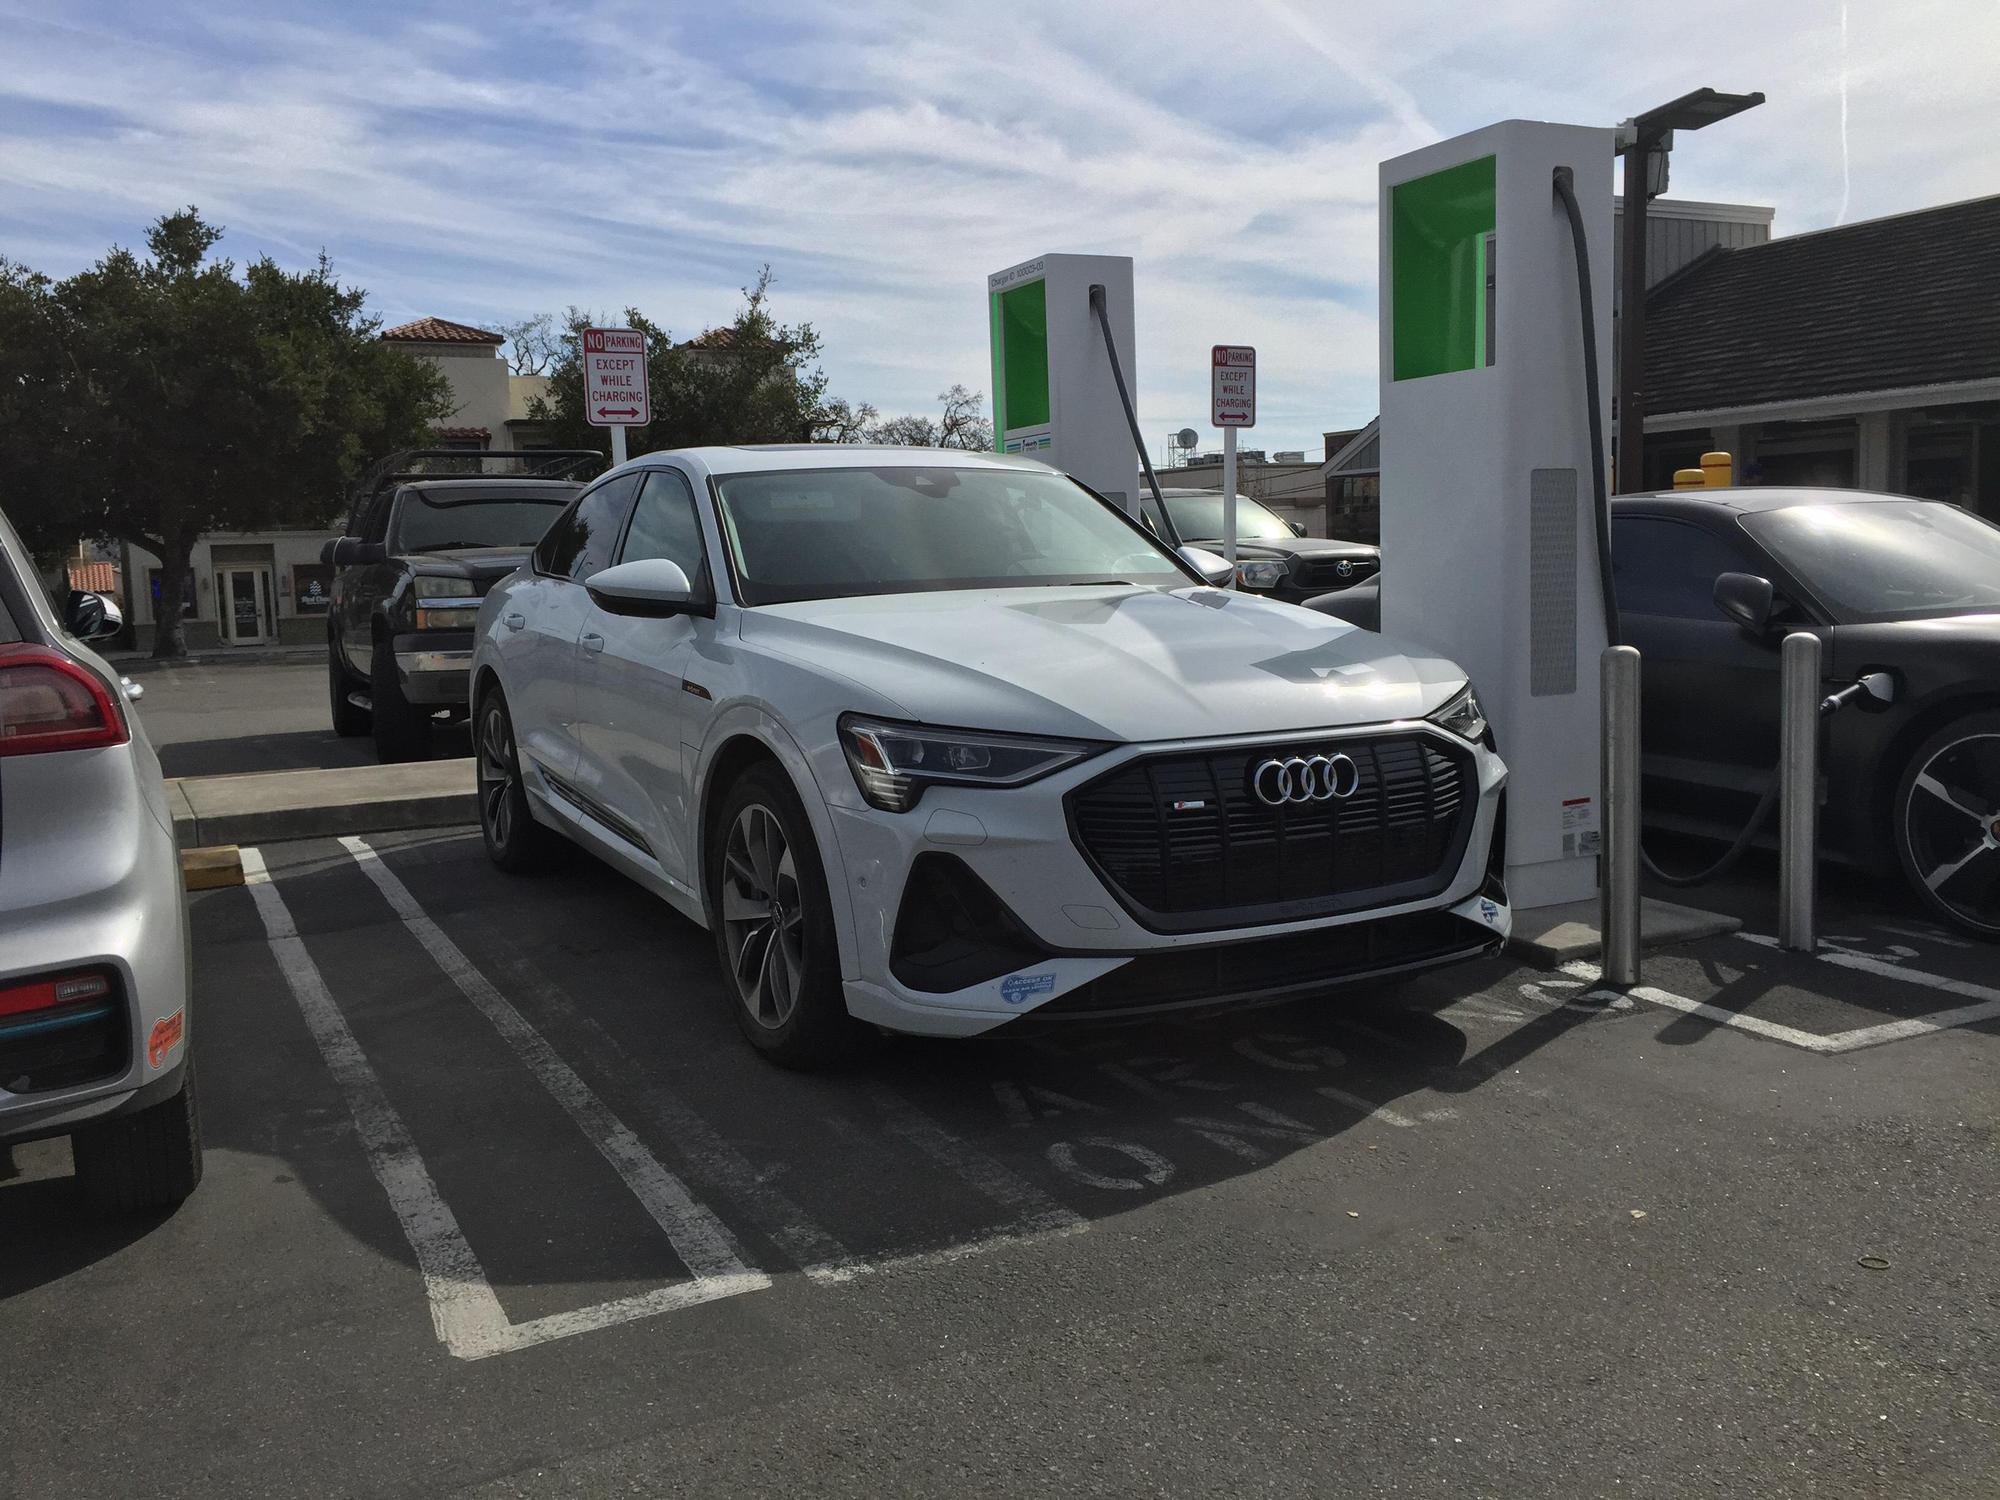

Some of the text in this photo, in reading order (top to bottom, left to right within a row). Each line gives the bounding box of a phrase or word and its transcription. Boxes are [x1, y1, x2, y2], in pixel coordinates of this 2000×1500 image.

[587, 333, 641, 349] NO PARKING
[1215, 350, 1253, 364] NO PARKING
[596, 359, 635, 371] EXCEPT
[601, 375, 633, 386] WHILE
[1220, 371, 1248, 381] EXCEPT
[1222, 385, 1245, 395] WHILE
[592, 391, 642, 402] CHARGING
[1216, 398, 1252, 408] CHARGING
[1045, 1086, 1462, 1191] ONL
